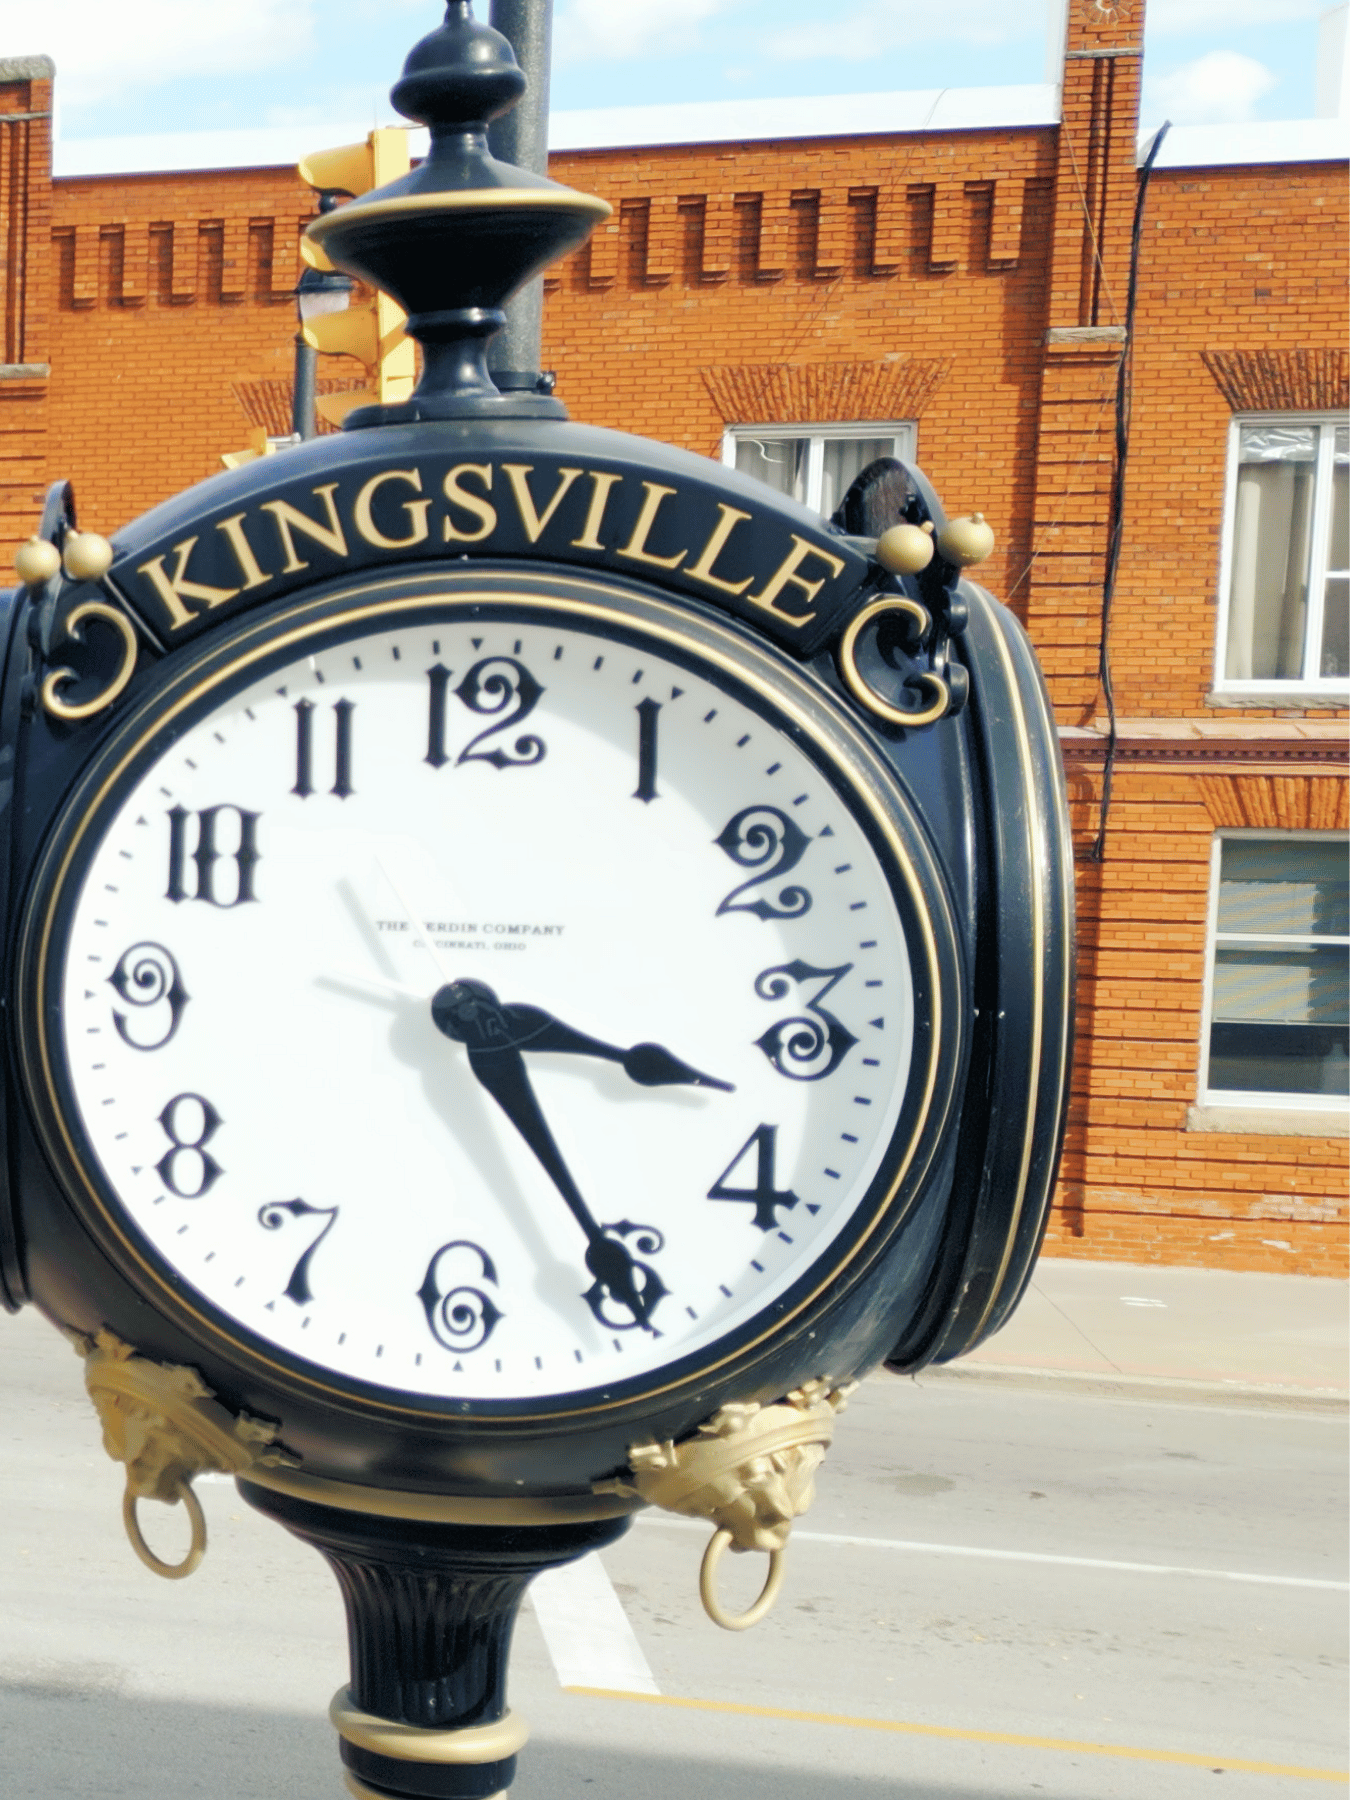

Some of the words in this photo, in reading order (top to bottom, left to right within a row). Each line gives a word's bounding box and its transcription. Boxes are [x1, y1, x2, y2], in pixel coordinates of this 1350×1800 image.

[137, 462, 845, 632] KINGSVILLE
[290, 696, 356, 800] 11
[422, 656, 547, 770] 12
[632, 696, 663, 804] 1
[162, 803, 263, 909] 10
[713, 804, 814, 921] 2
[376, 920, 410, 931] THE
[421, 921, 479, 934] ERDIN
[482, 923, 565, 936] COMPANY
[493, 941, 528, 951] OHIO
[107, 940, 191, 1052] 9
[754, 958, 861, 1083] 3
[154, 1092, 225, 1200] 8
[706, 1122, 801, 1234] 4
[257, 1197, 340, 1307] 7
[415, 1239, 506, 1355] 6
